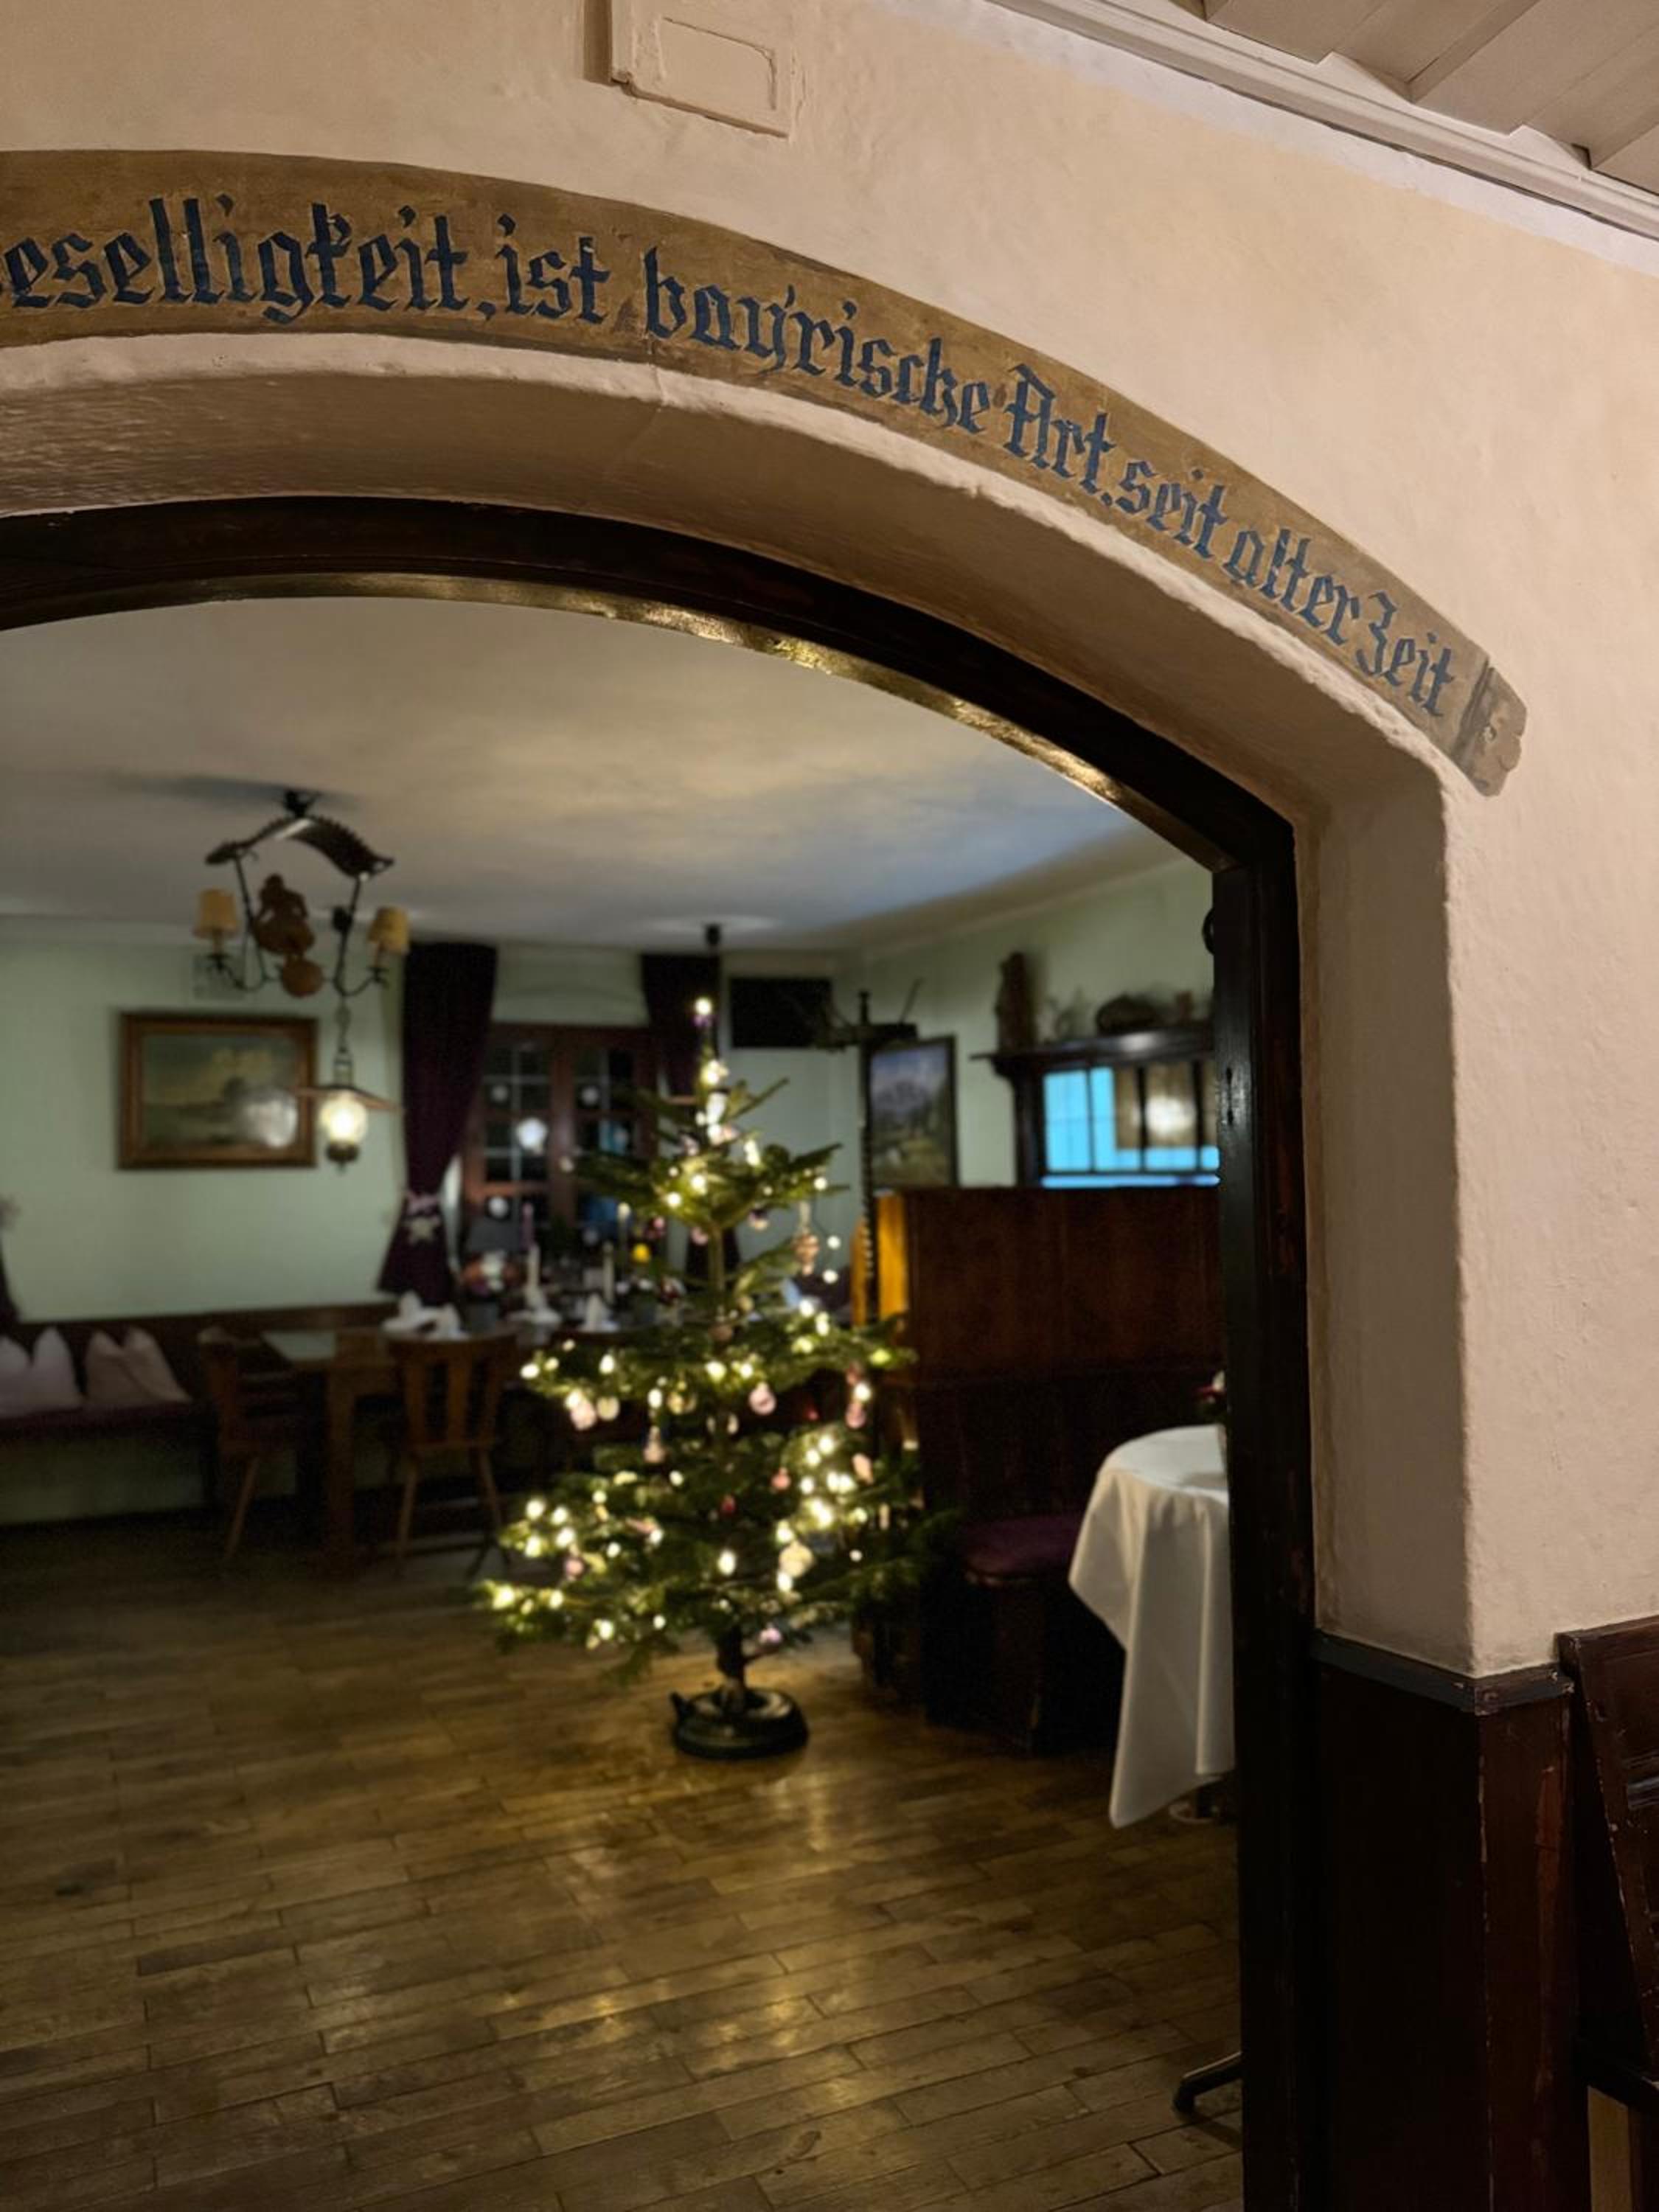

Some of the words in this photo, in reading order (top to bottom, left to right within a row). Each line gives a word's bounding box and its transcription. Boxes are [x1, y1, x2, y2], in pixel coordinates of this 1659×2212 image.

[495, 214, 611, 324] ist
[1116, 461, 1228, 558] seit
[1222, 526, 1360, 646] alter
